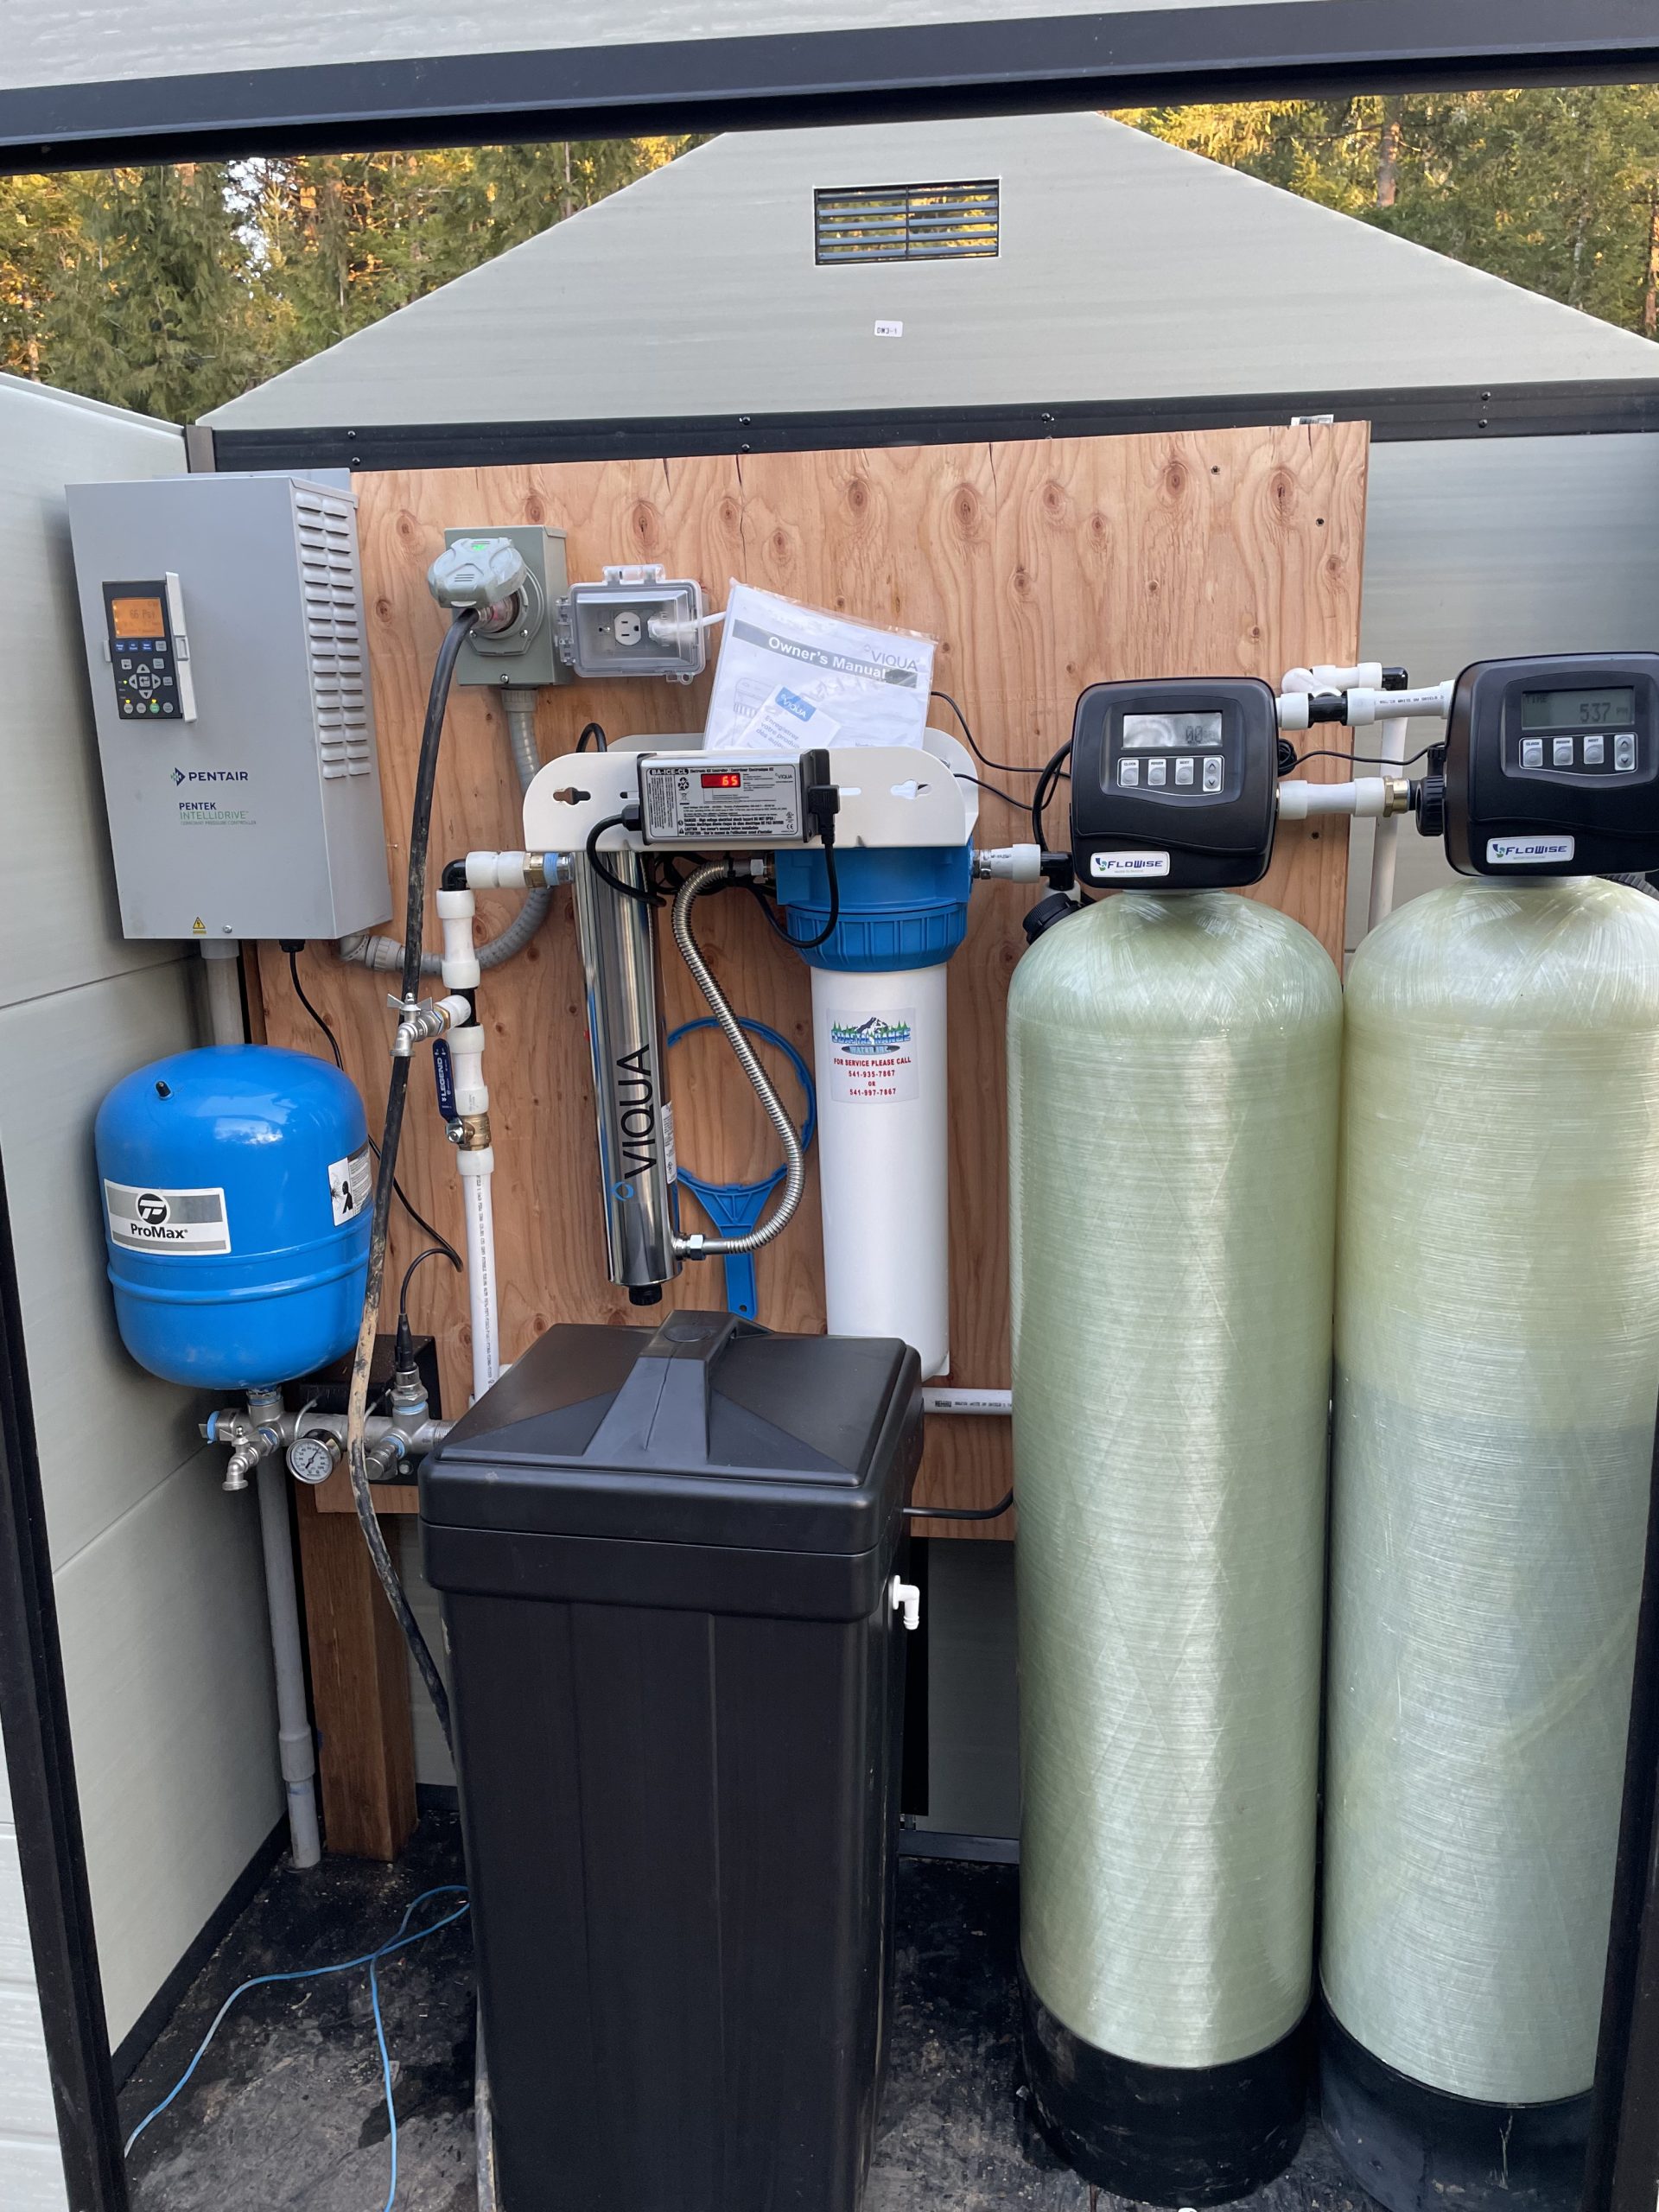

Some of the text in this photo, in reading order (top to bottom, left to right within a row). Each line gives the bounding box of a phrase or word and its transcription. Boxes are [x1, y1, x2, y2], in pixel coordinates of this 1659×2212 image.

[768, 636, 887, 680] Owner's Manual
[870, 649, 918, 672] VIQUA
[783, 696, 807, 718] VIQUA
[188, 771, 249, 782] PENTAIR
[721, 775, 738, 786] 65
[179, 802, 217, 810] PENTEK
[436, 1057, 447, 1096] LEGEND
[616, 1043, 658, 1179] VIQUA
[130, 1223, 186, 1239] ProMax
